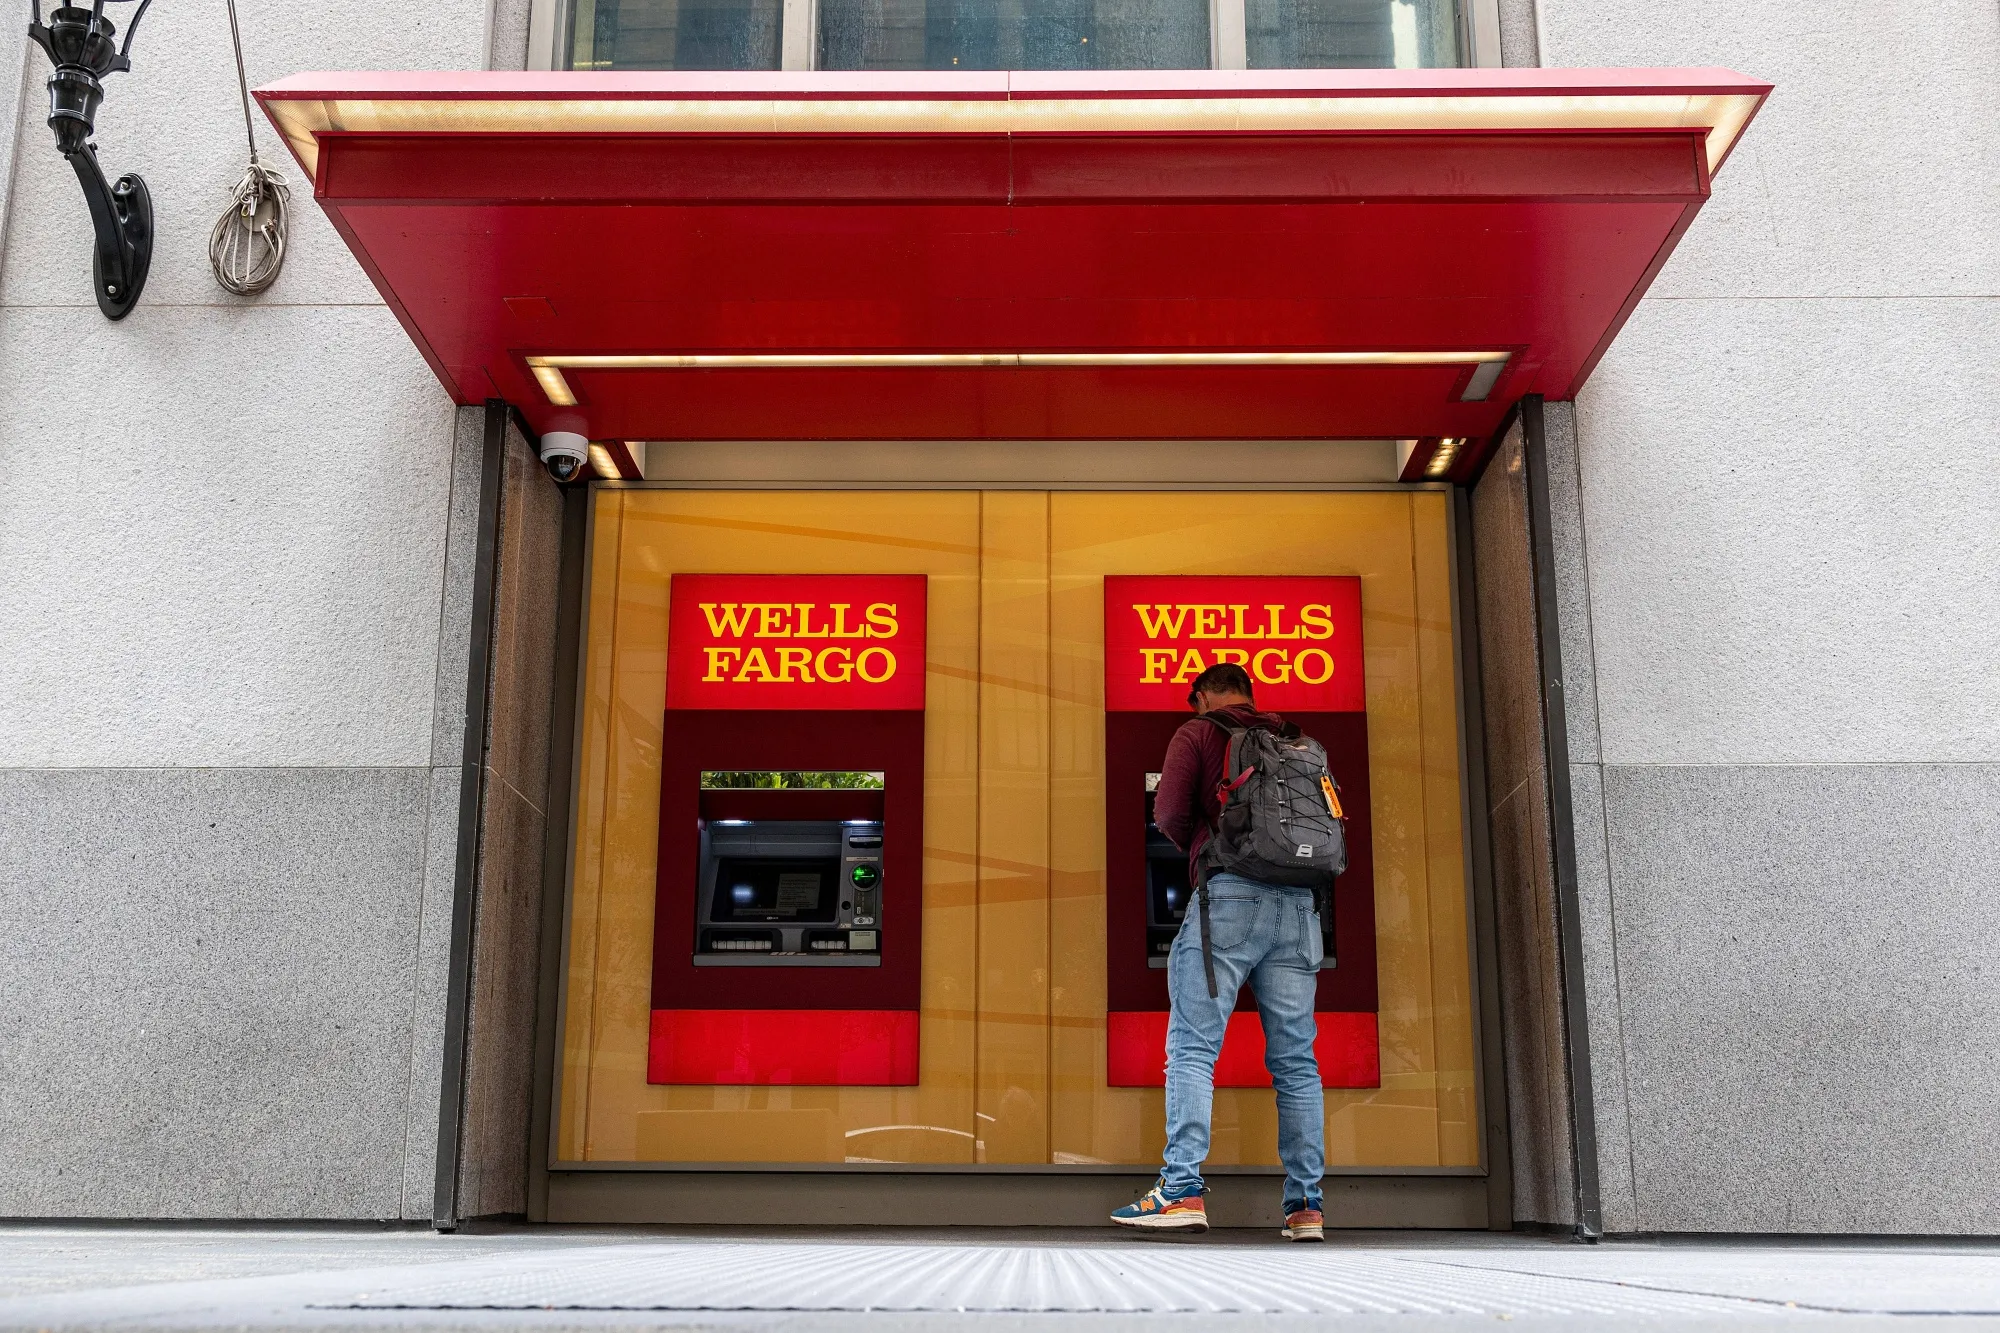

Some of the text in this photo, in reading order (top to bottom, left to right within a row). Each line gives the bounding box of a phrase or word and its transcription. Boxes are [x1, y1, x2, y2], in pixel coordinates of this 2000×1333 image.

[699, 603, 899, 639] WELLS
[1133, 604, 1335, 640] WELLS
[701, 646, 897, 683] FARGO
[1140, 1197, 1155, 1213] N
